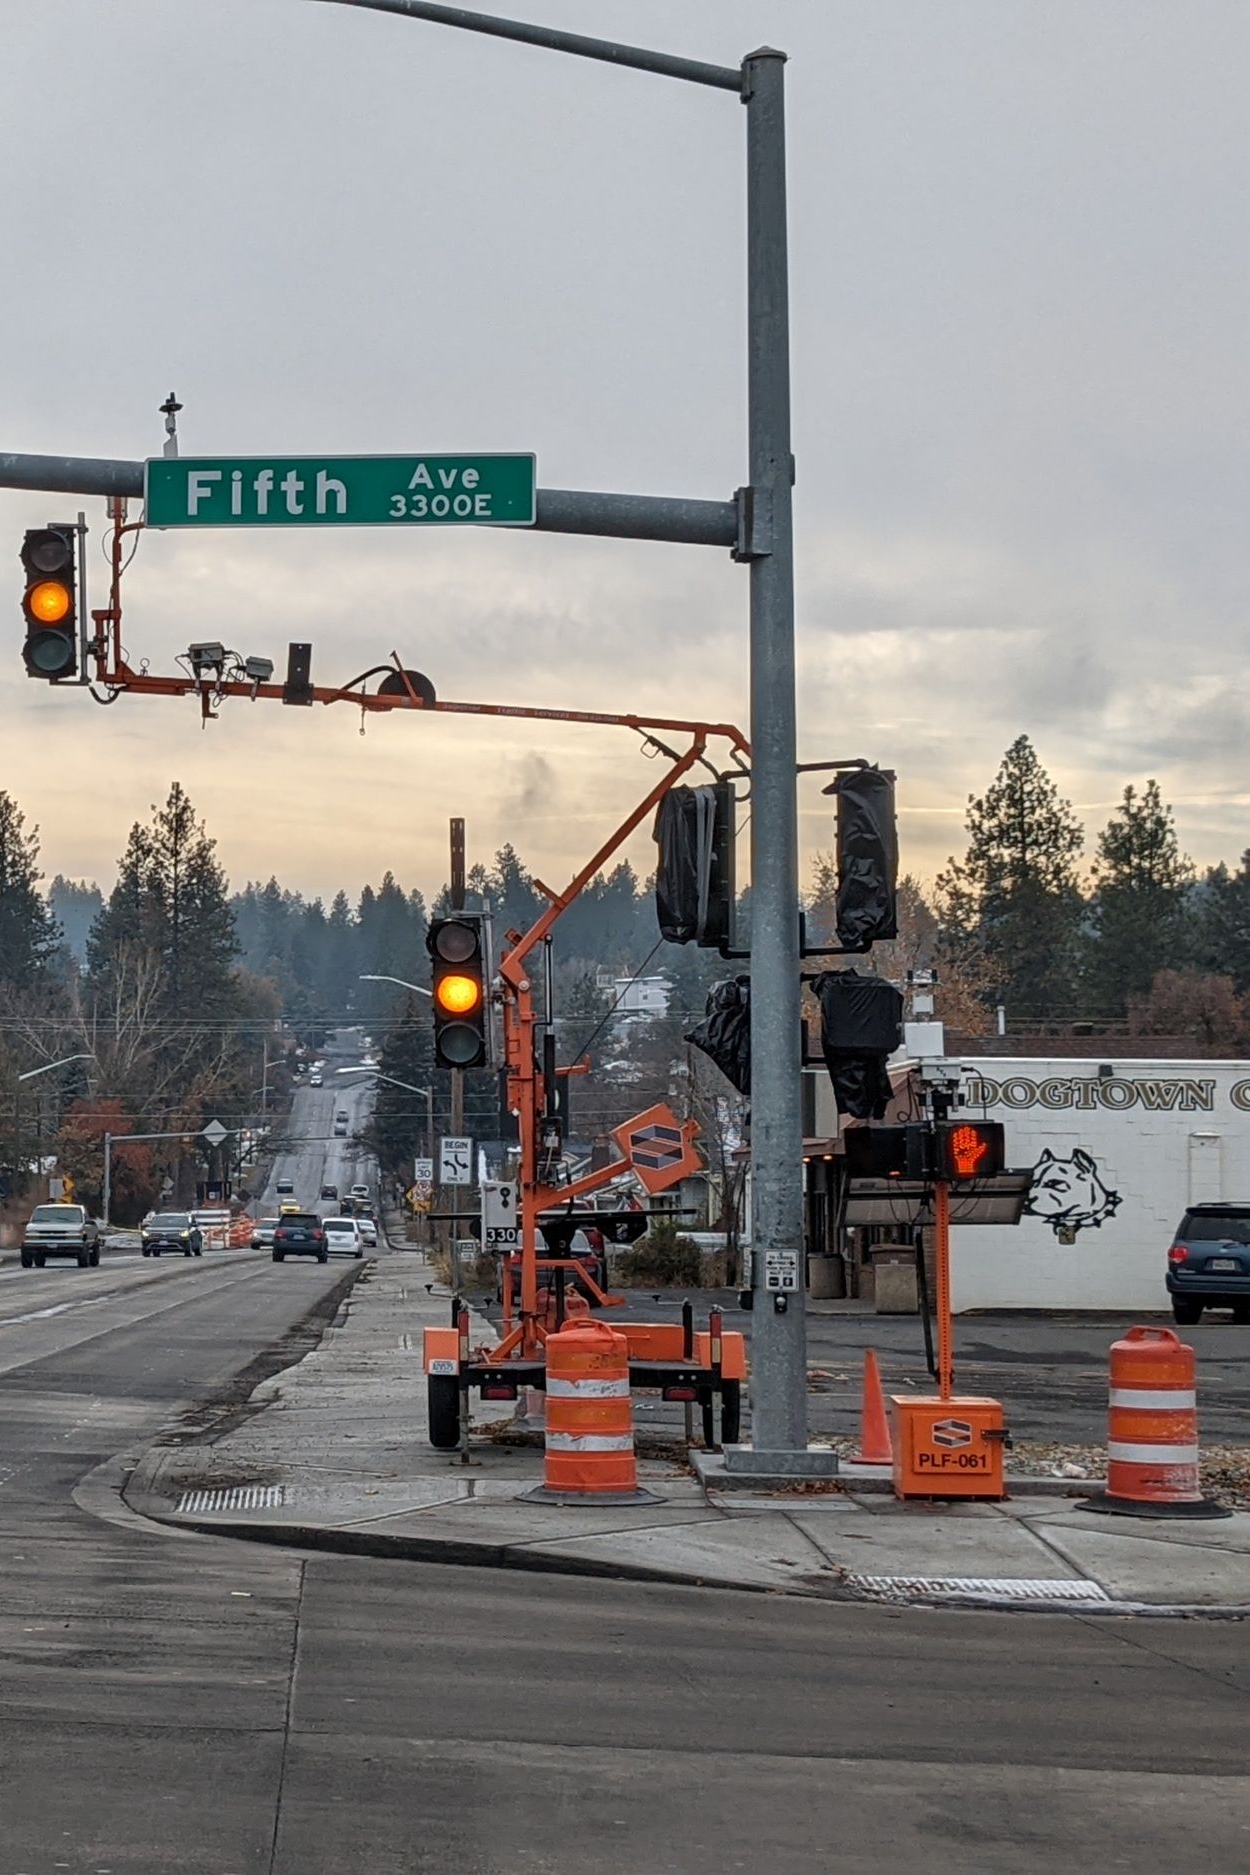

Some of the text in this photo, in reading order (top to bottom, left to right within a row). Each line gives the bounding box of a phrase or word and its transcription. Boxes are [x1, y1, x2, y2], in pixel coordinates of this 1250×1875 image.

[187, 462, 480, 516] Fifth Ave
[389, 493, 492, 517] 3300E
[965, 1076, 1216, 1111] DOGTOWN
[444, 1140, 468, 1149] BEGIN
[417, 1169, 431, 1178] 30
[487, 1228, 516, 1241] 330
[919, 1453, 986, 1468] PLF-061
